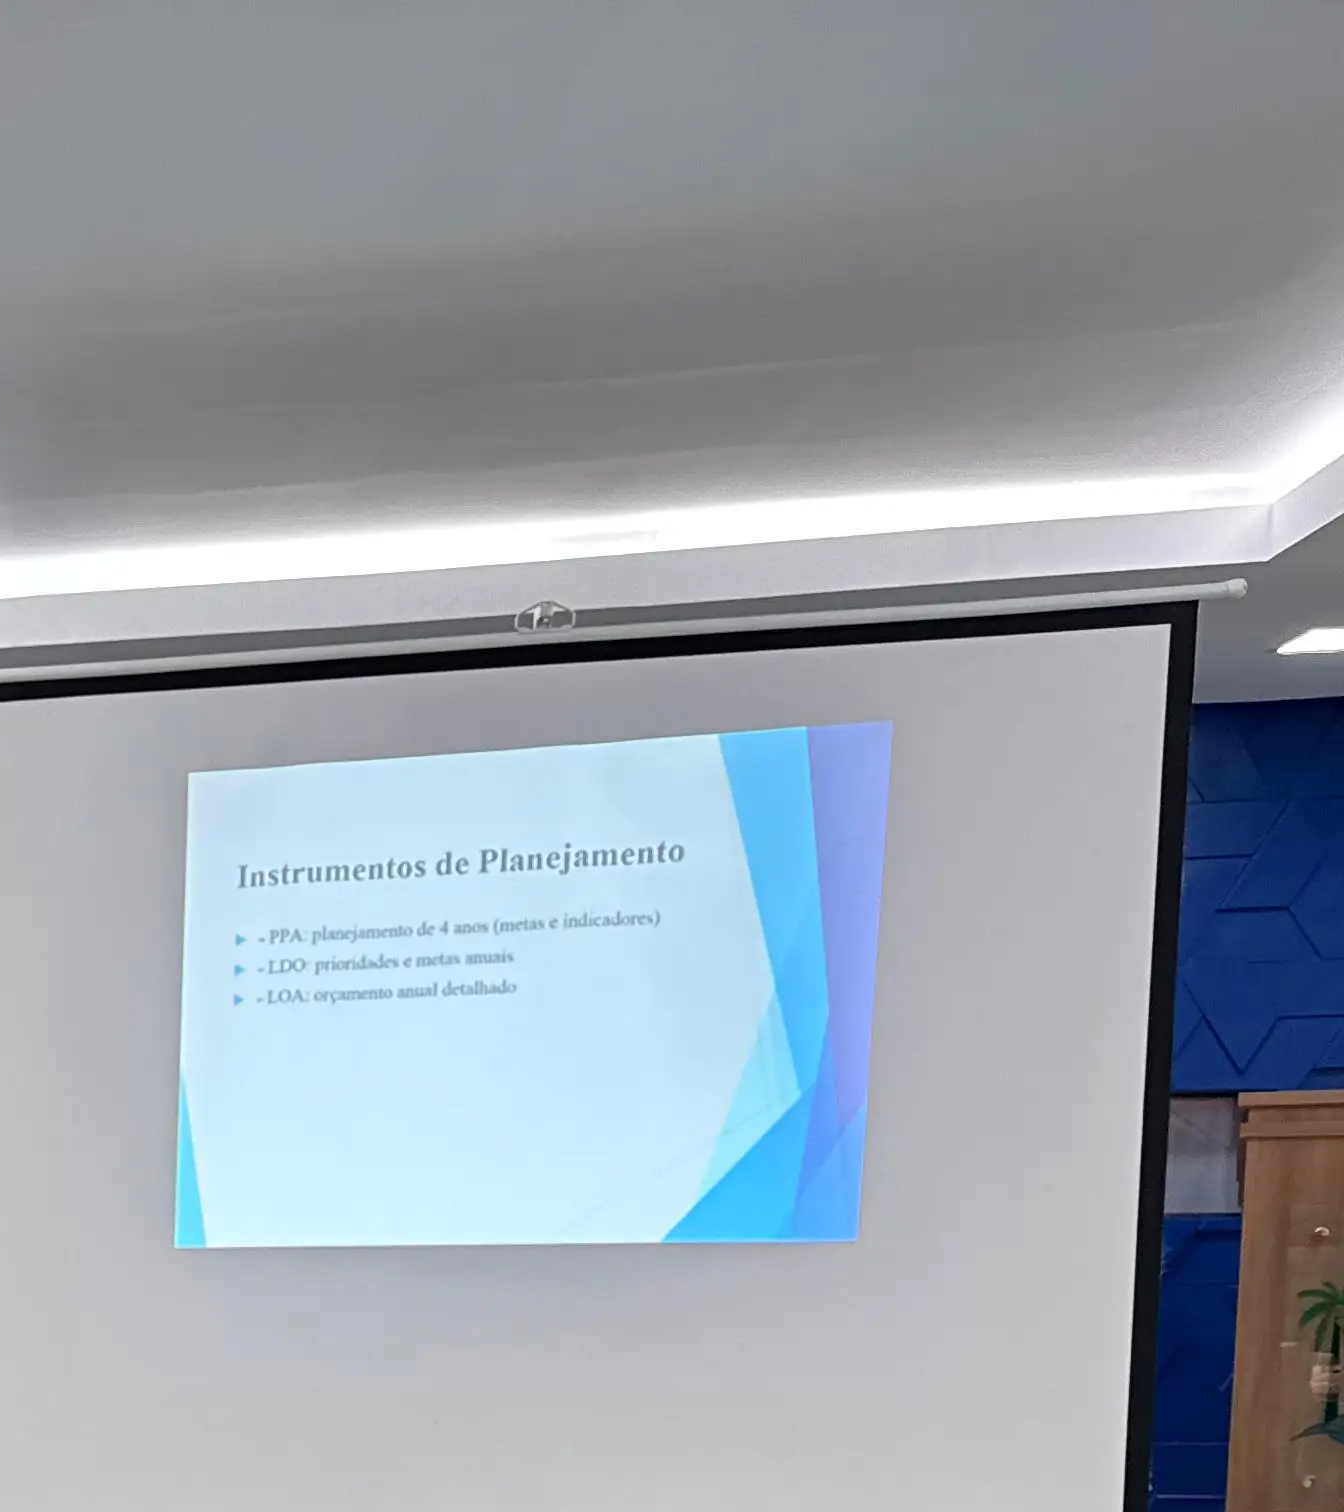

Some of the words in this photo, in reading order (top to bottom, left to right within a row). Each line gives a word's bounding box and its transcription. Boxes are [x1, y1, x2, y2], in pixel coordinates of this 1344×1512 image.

[237, 857, 427, 889] Instrumentos
[435, 851, 470, 876] de
[478, 840, 685, 876] Planejamento
[311, 922, 414, 946] planejamento
[416, 920, 436, 937] de
[438, 920, 449, 937] 4
[453, 919, 489, 935] anos
[493, 917, 546, 936] (metas
[548, 916, 559, 930] e
[562, 910, 662, 931] indicadores)
[314, 953, 400, 976] prioridades
[402, 954, 413, 969] e
[415, 951, 461, 968] metas
[464, 948, 514, 966] anuais
[313, 985, 393, 1006] orçamento
[396, 982, 438, 999] anual
[441, 979, 517, 997] detalhado
